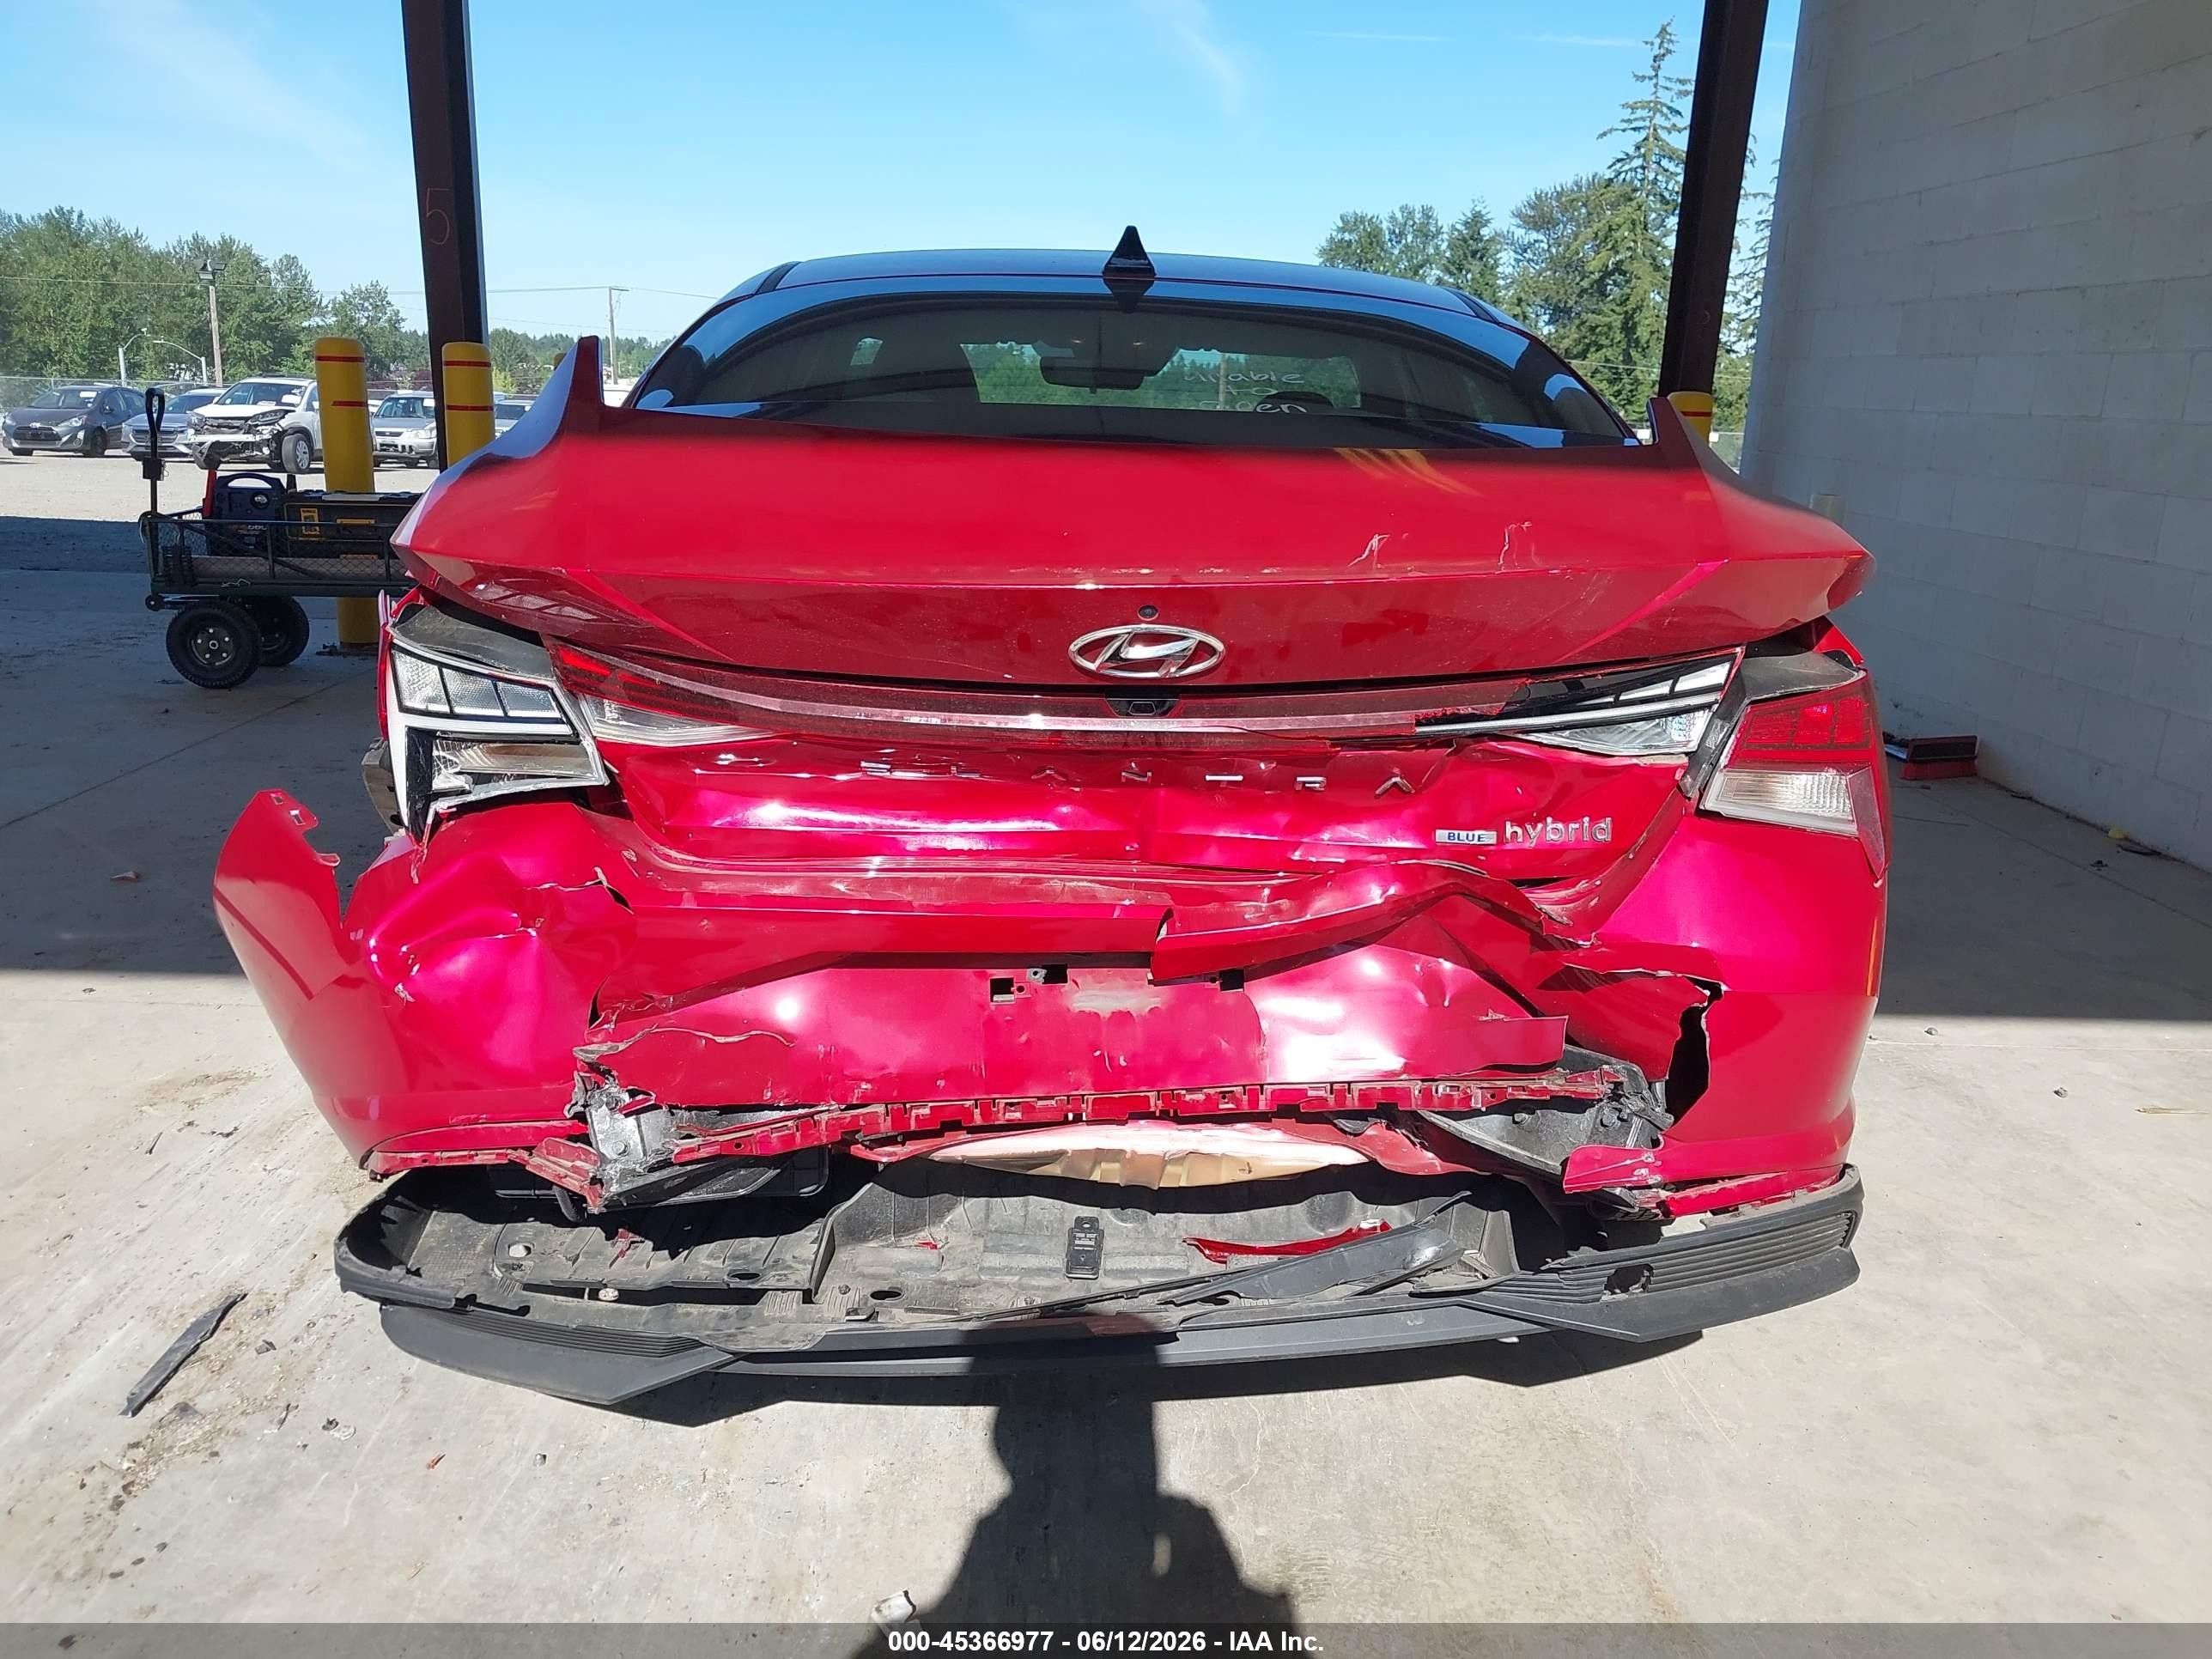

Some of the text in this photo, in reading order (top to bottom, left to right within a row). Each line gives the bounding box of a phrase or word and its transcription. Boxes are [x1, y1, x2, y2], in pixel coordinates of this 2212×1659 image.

[425, 186, 452, 246] 5
[1224, 385, 1279, 396] to
[1447, 816, 1612, 848] BLUE hybrid
